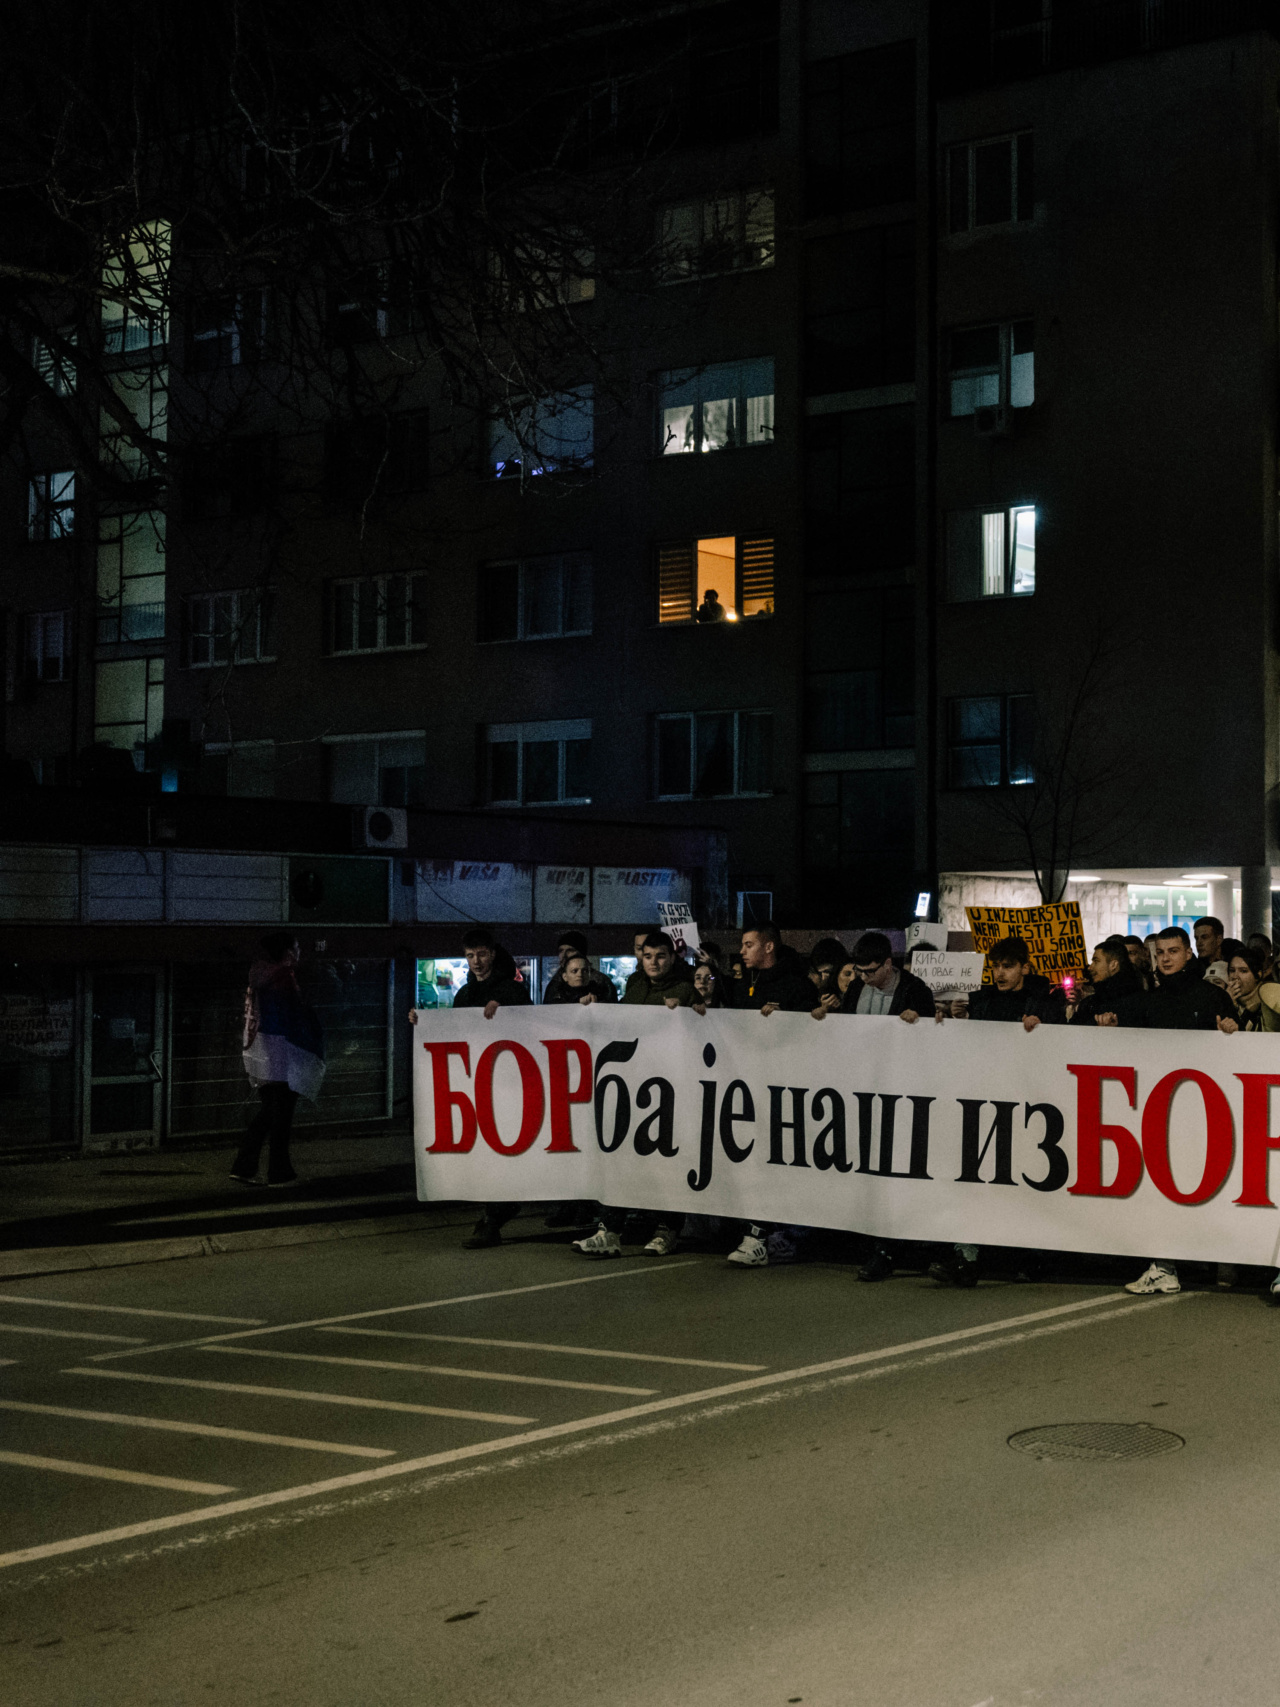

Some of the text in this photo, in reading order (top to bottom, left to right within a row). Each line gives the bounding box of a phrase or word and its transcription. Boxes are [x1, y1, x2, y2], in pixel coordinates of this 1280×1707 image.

[969, 902, 1080, 923] U INŽENJERSTVU
[973, 920, 1079, 939] NEMA MESTA ZA
[1050, 935, 1084, 952] SAMO
[1033, 950, 1089, 970] TRUČNOST
[932, 967, 954, 977] ОВДЕ
[960, 967, 972, 977] НЕ
[424, 1038, 679, 1157] БОРба
[686, 1042, 755, 1192] је
[768, 1084, 936, 1181] наш
